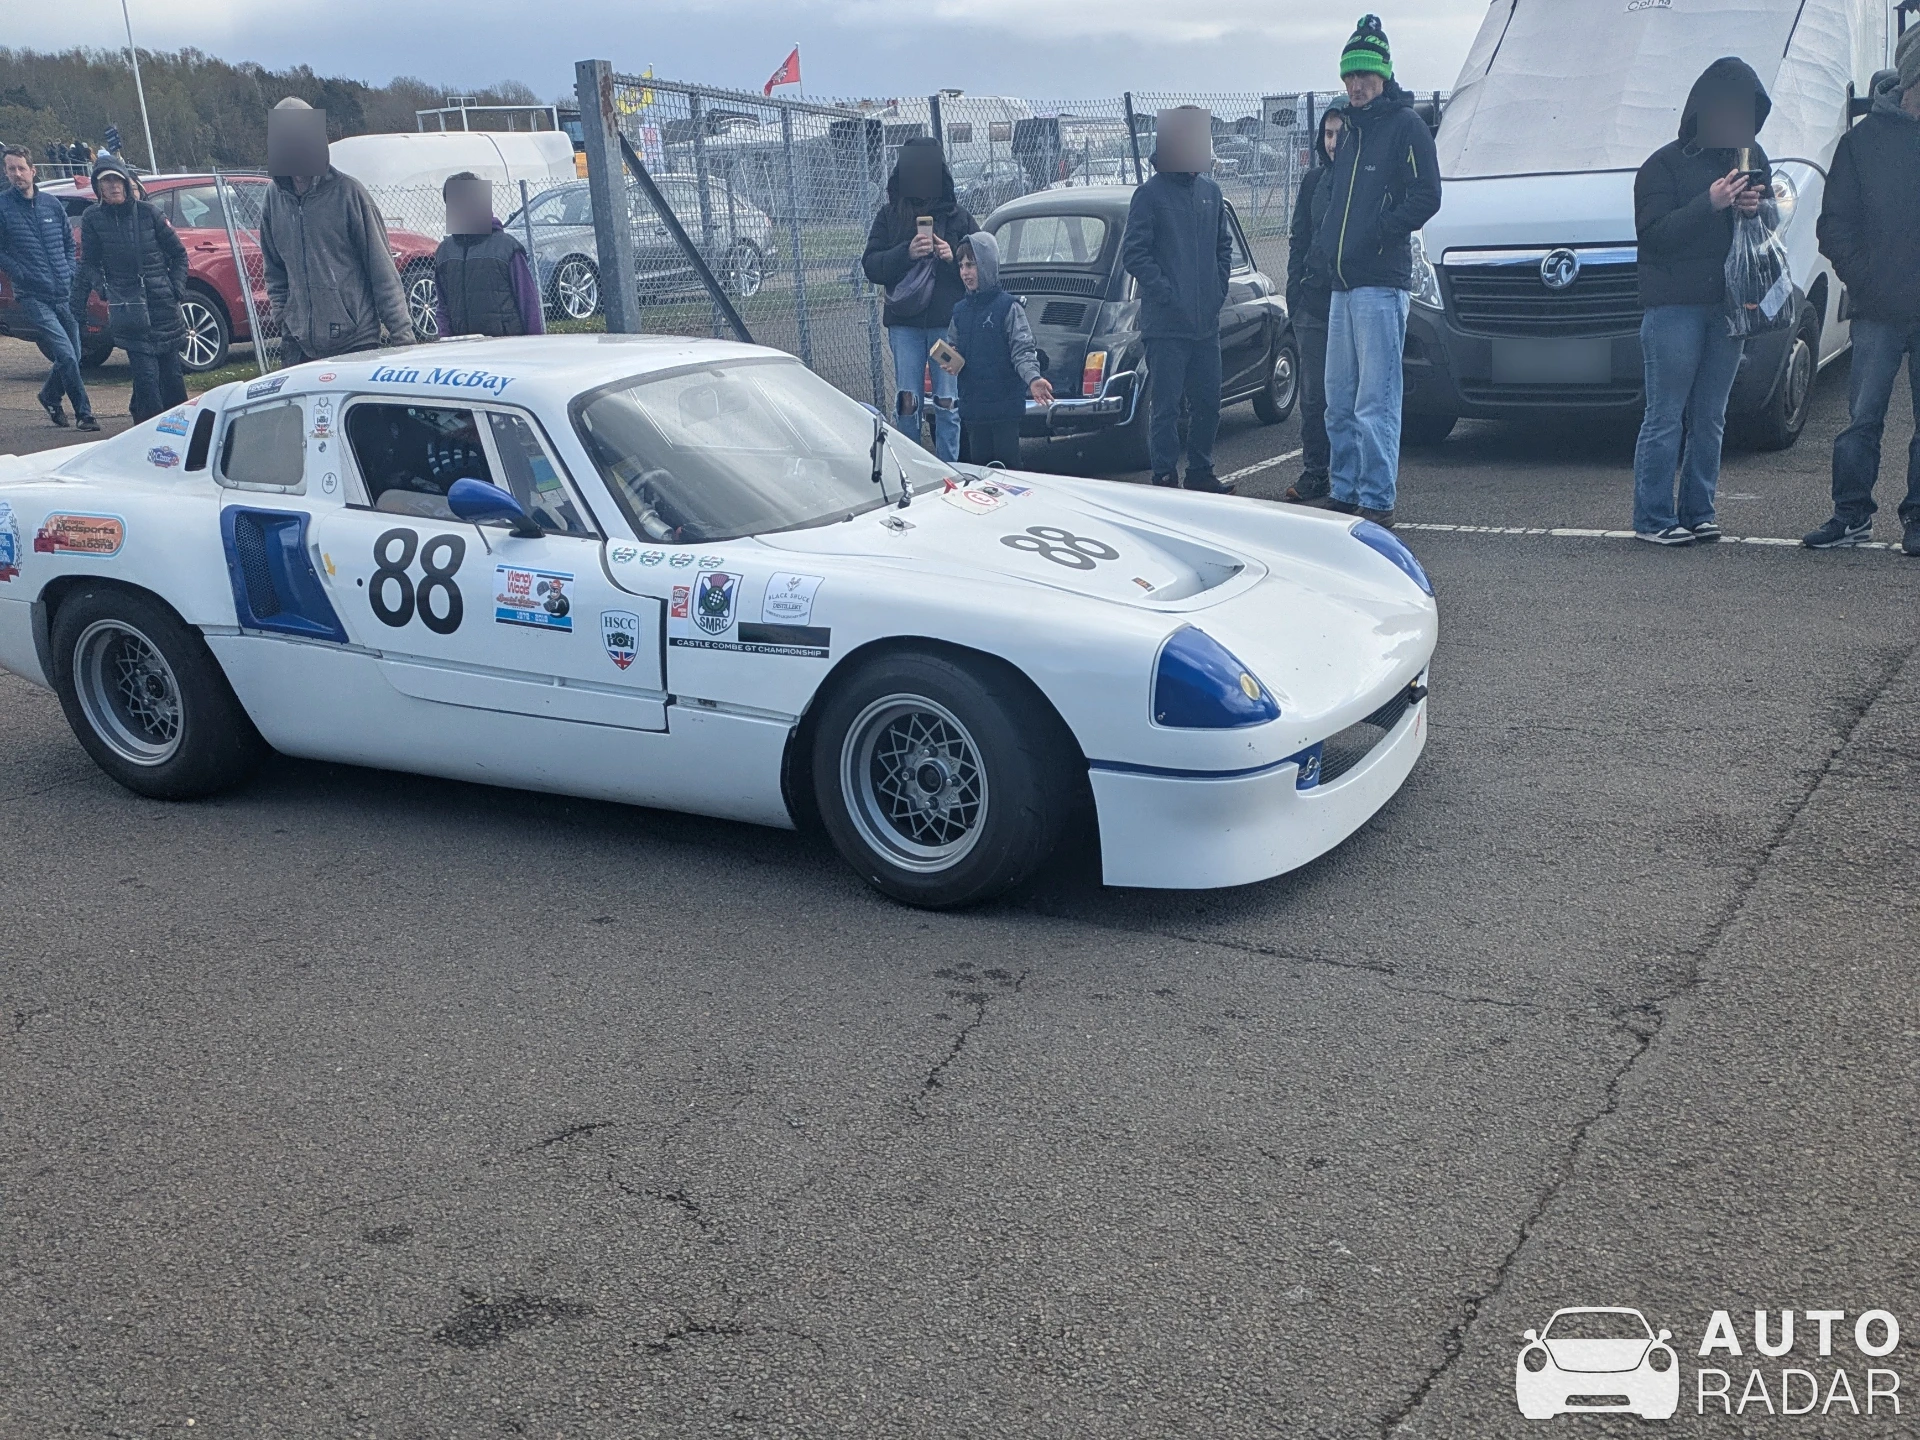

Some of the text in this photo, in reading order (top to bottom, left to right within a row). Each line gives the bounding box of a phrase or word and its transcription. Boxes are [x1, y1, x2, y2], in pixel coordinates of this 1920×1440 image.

[369, 365, 516, 396] Iain McBay
[56, 523, 115, 535] Modsports
[70, 539, 114, 550] Saloons
[1000, 526, 1119, 570] 88
[368, 528, 467, 635] 88
[507, 570, 534, 587] Wendy
[768, 593, 788, 601] BLACK
[604, 616, 636, 630] HSCC
[699, 616, 728, 632] SMRC
[676, 639, 711, 648] CASTLE
[712, 642, 744, 651] COMBE
[758, 646, 822, 657] CHAMPIONSHIP
